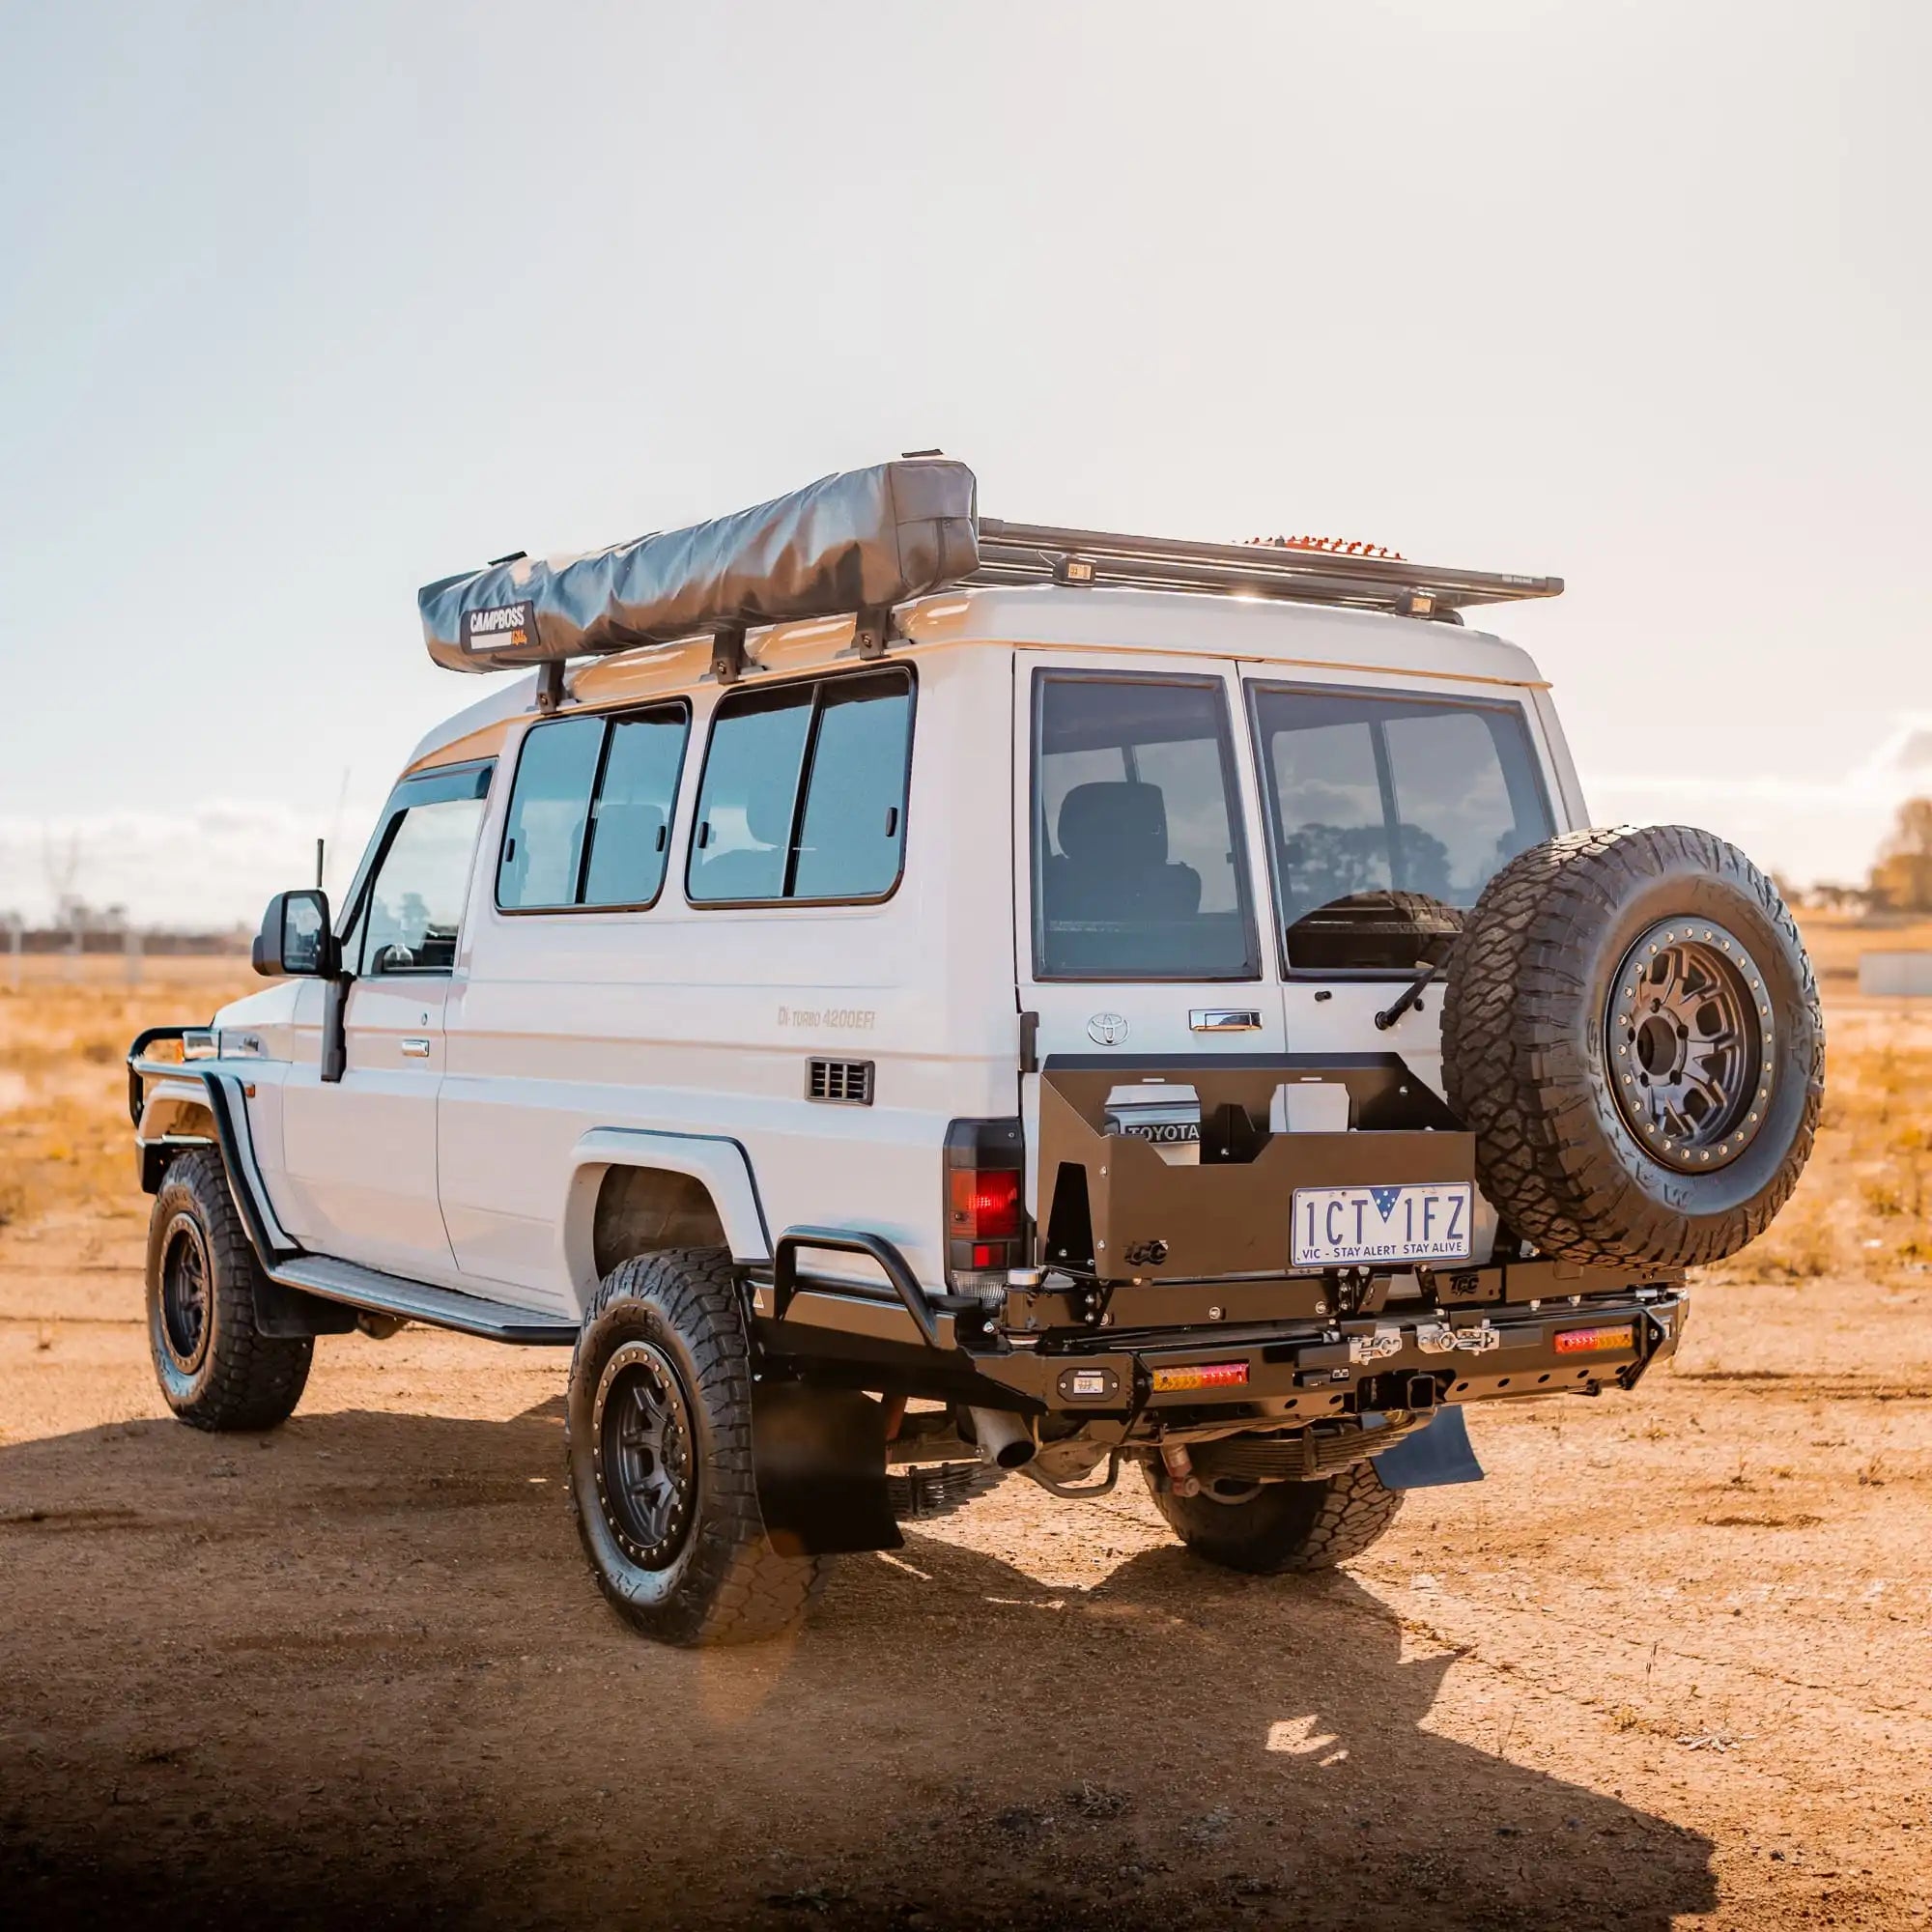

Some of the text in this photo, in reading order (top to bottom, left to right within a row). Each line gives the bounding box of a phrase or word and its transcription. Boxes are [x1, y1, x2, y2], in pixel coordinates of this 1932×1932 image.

[469, 605, 526, 634] CAMPBOSS
[792, 1009, 821, 1028] TURBO
[1307, 1195, 1464, 1247] 1CT 1FZ
[1302, 1248, 1321, 1260] VIC
[1333, 1246, 1361, 1258] STAY
[1363, 1244, 1397, 1257] ALERT
[1403, 1243, 1430, 1254] STAY
[1432, 1241, 1463, 1253] ALIVE
